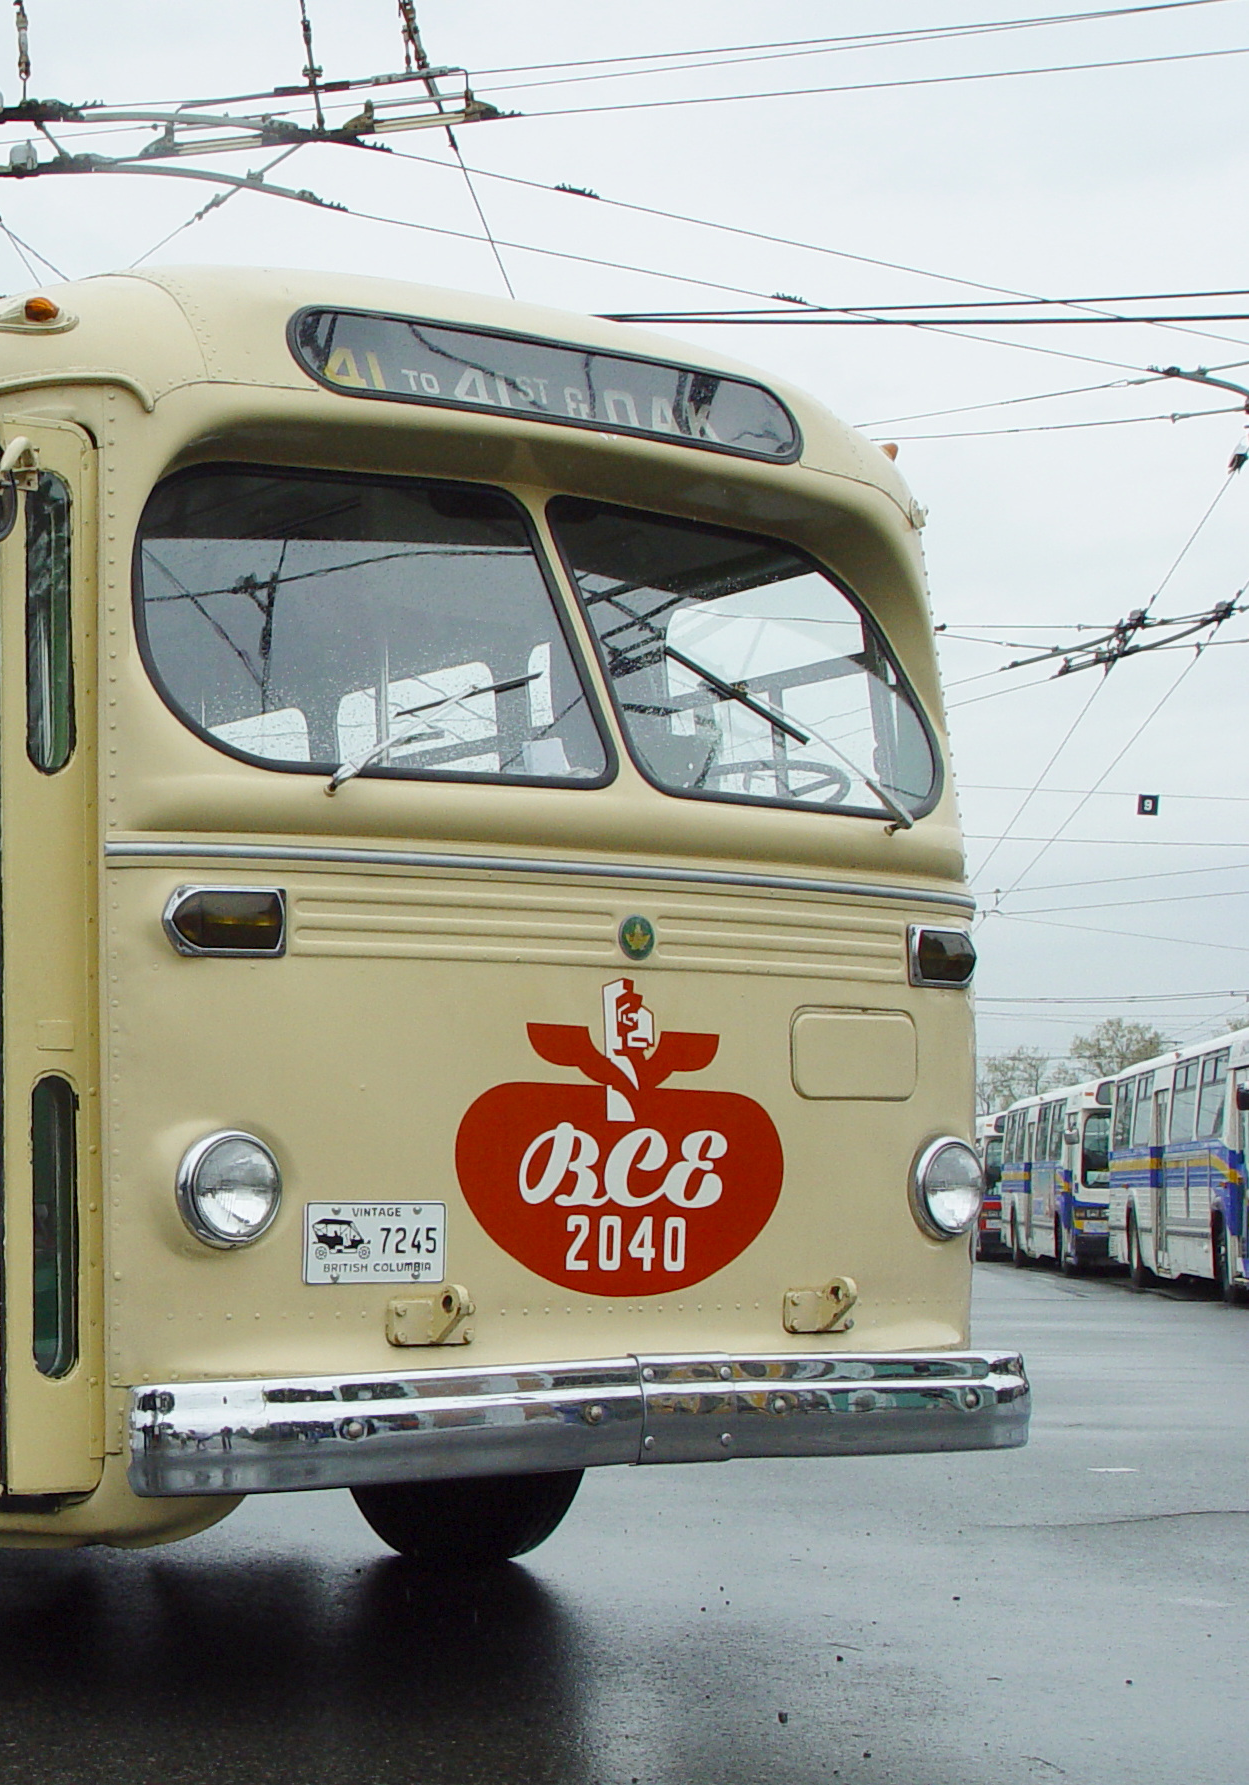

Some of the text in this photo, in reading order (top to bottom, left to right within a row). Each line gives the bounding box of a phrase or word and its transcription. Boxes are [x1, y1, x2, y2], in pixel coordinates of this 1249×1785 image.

[323, 347, 387, 390] 41
[401, 368, 440, 395] TO
[1143, 799, 1153, 811] 9
[518, 1121, 729, 1209] BCE
[352, 1207, 402, 1217] VINTAGE
[380, 1227, 437, 1254] 7245
[565, 1214, 687, 1272] 2040
[323, 1262, 432, 1273] BRITISH COLUMBIA
